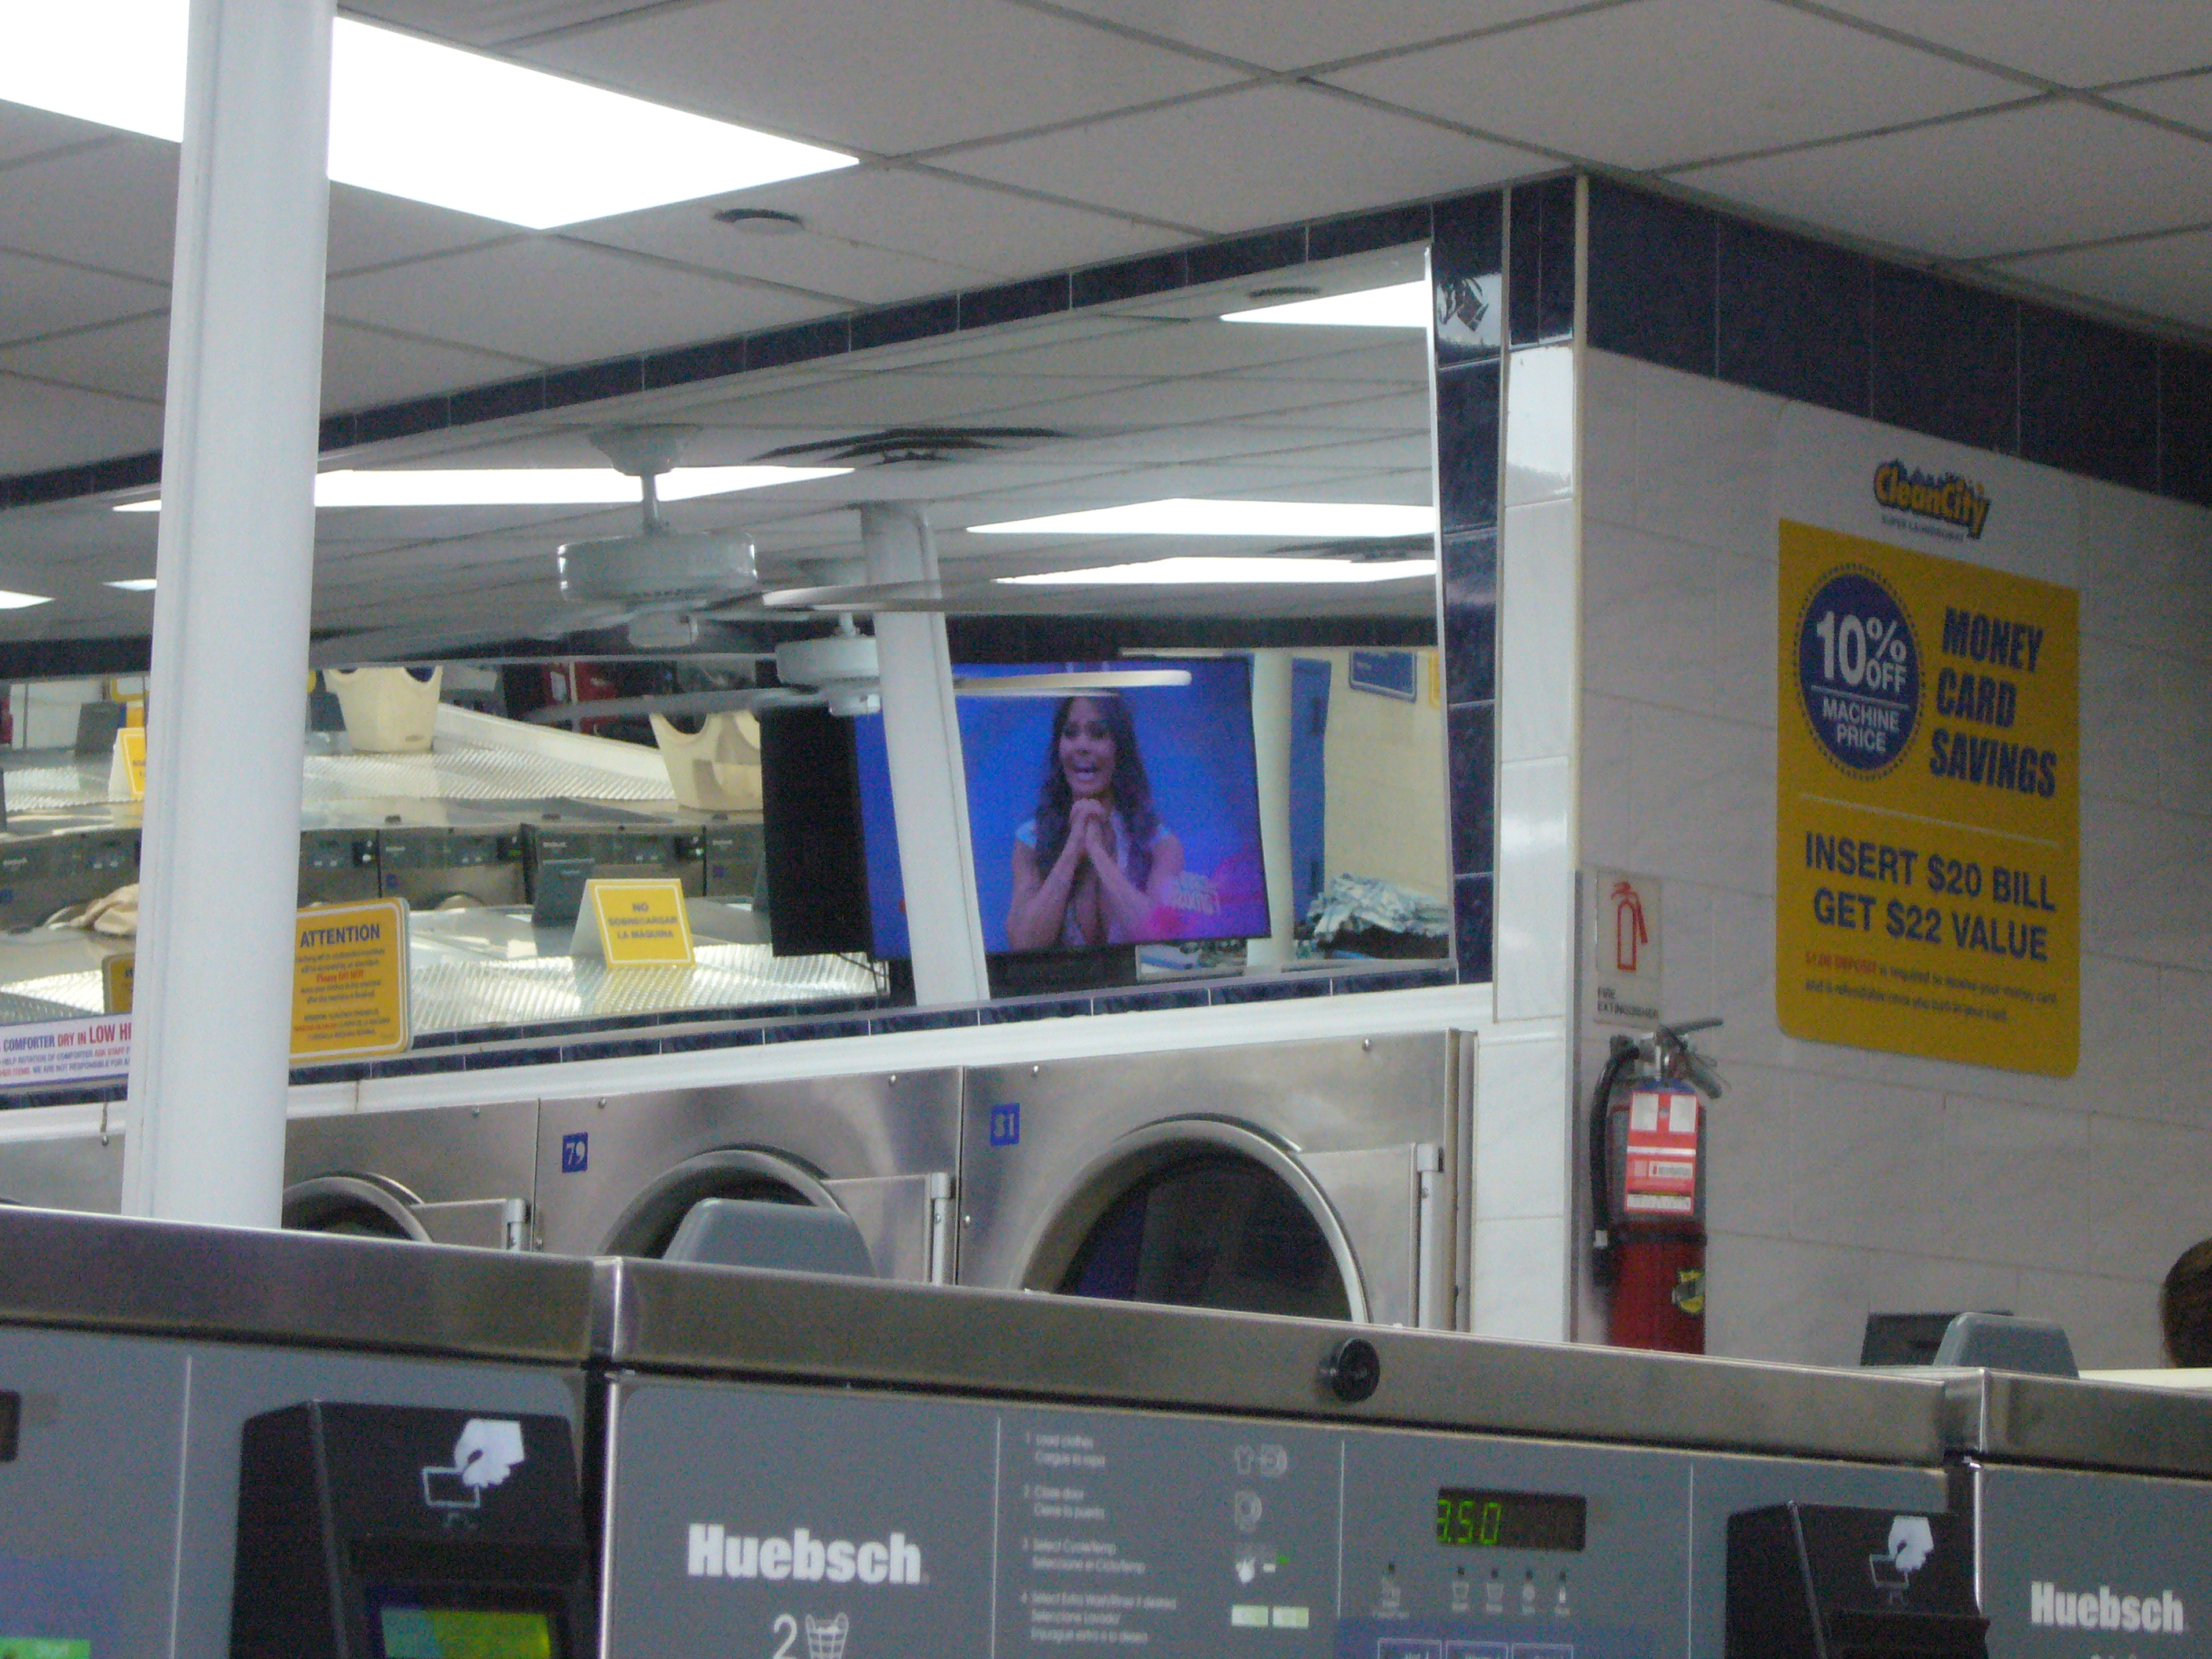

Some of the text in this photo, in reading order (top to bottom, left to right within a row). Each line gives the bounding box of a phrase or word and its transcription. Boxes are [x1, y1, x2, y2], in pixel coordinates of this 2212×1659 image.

[1874, 459, 1992, 540] CleanCity
[1817, 611, 1907, 686] 10%
[1943, 606, 2042, 673] MONEY
[1866, 661, 1907, 694] OFF
[1936, 667, 2017, 728] CARD
[1822, 697, 1899, 733] MACHINE
[1837, 723, 1886, 753] PRICE
[1929, 728, 2057, 798] SAVINGS
[1805, 831, 2057, 913] INSERT $20 BILL
[300, 924, 381, 947] ATTENTION
[1814, 887, 2049, 962] GET $22 VALUE
[4, 1034, 55, 1052] COMFORTER
[57, 1031, 75, 1047] DRY
[77, 1031, 86, 1045] IN
[90, 1024, 115, 1044] LOW
[565, 1140, 586, 1165] 79
[687, 1522, 922, 1585] Huebsch
[772, 1612, 798, 1659] 2
[2030, 1580, 2185, 1635] Huebsch
